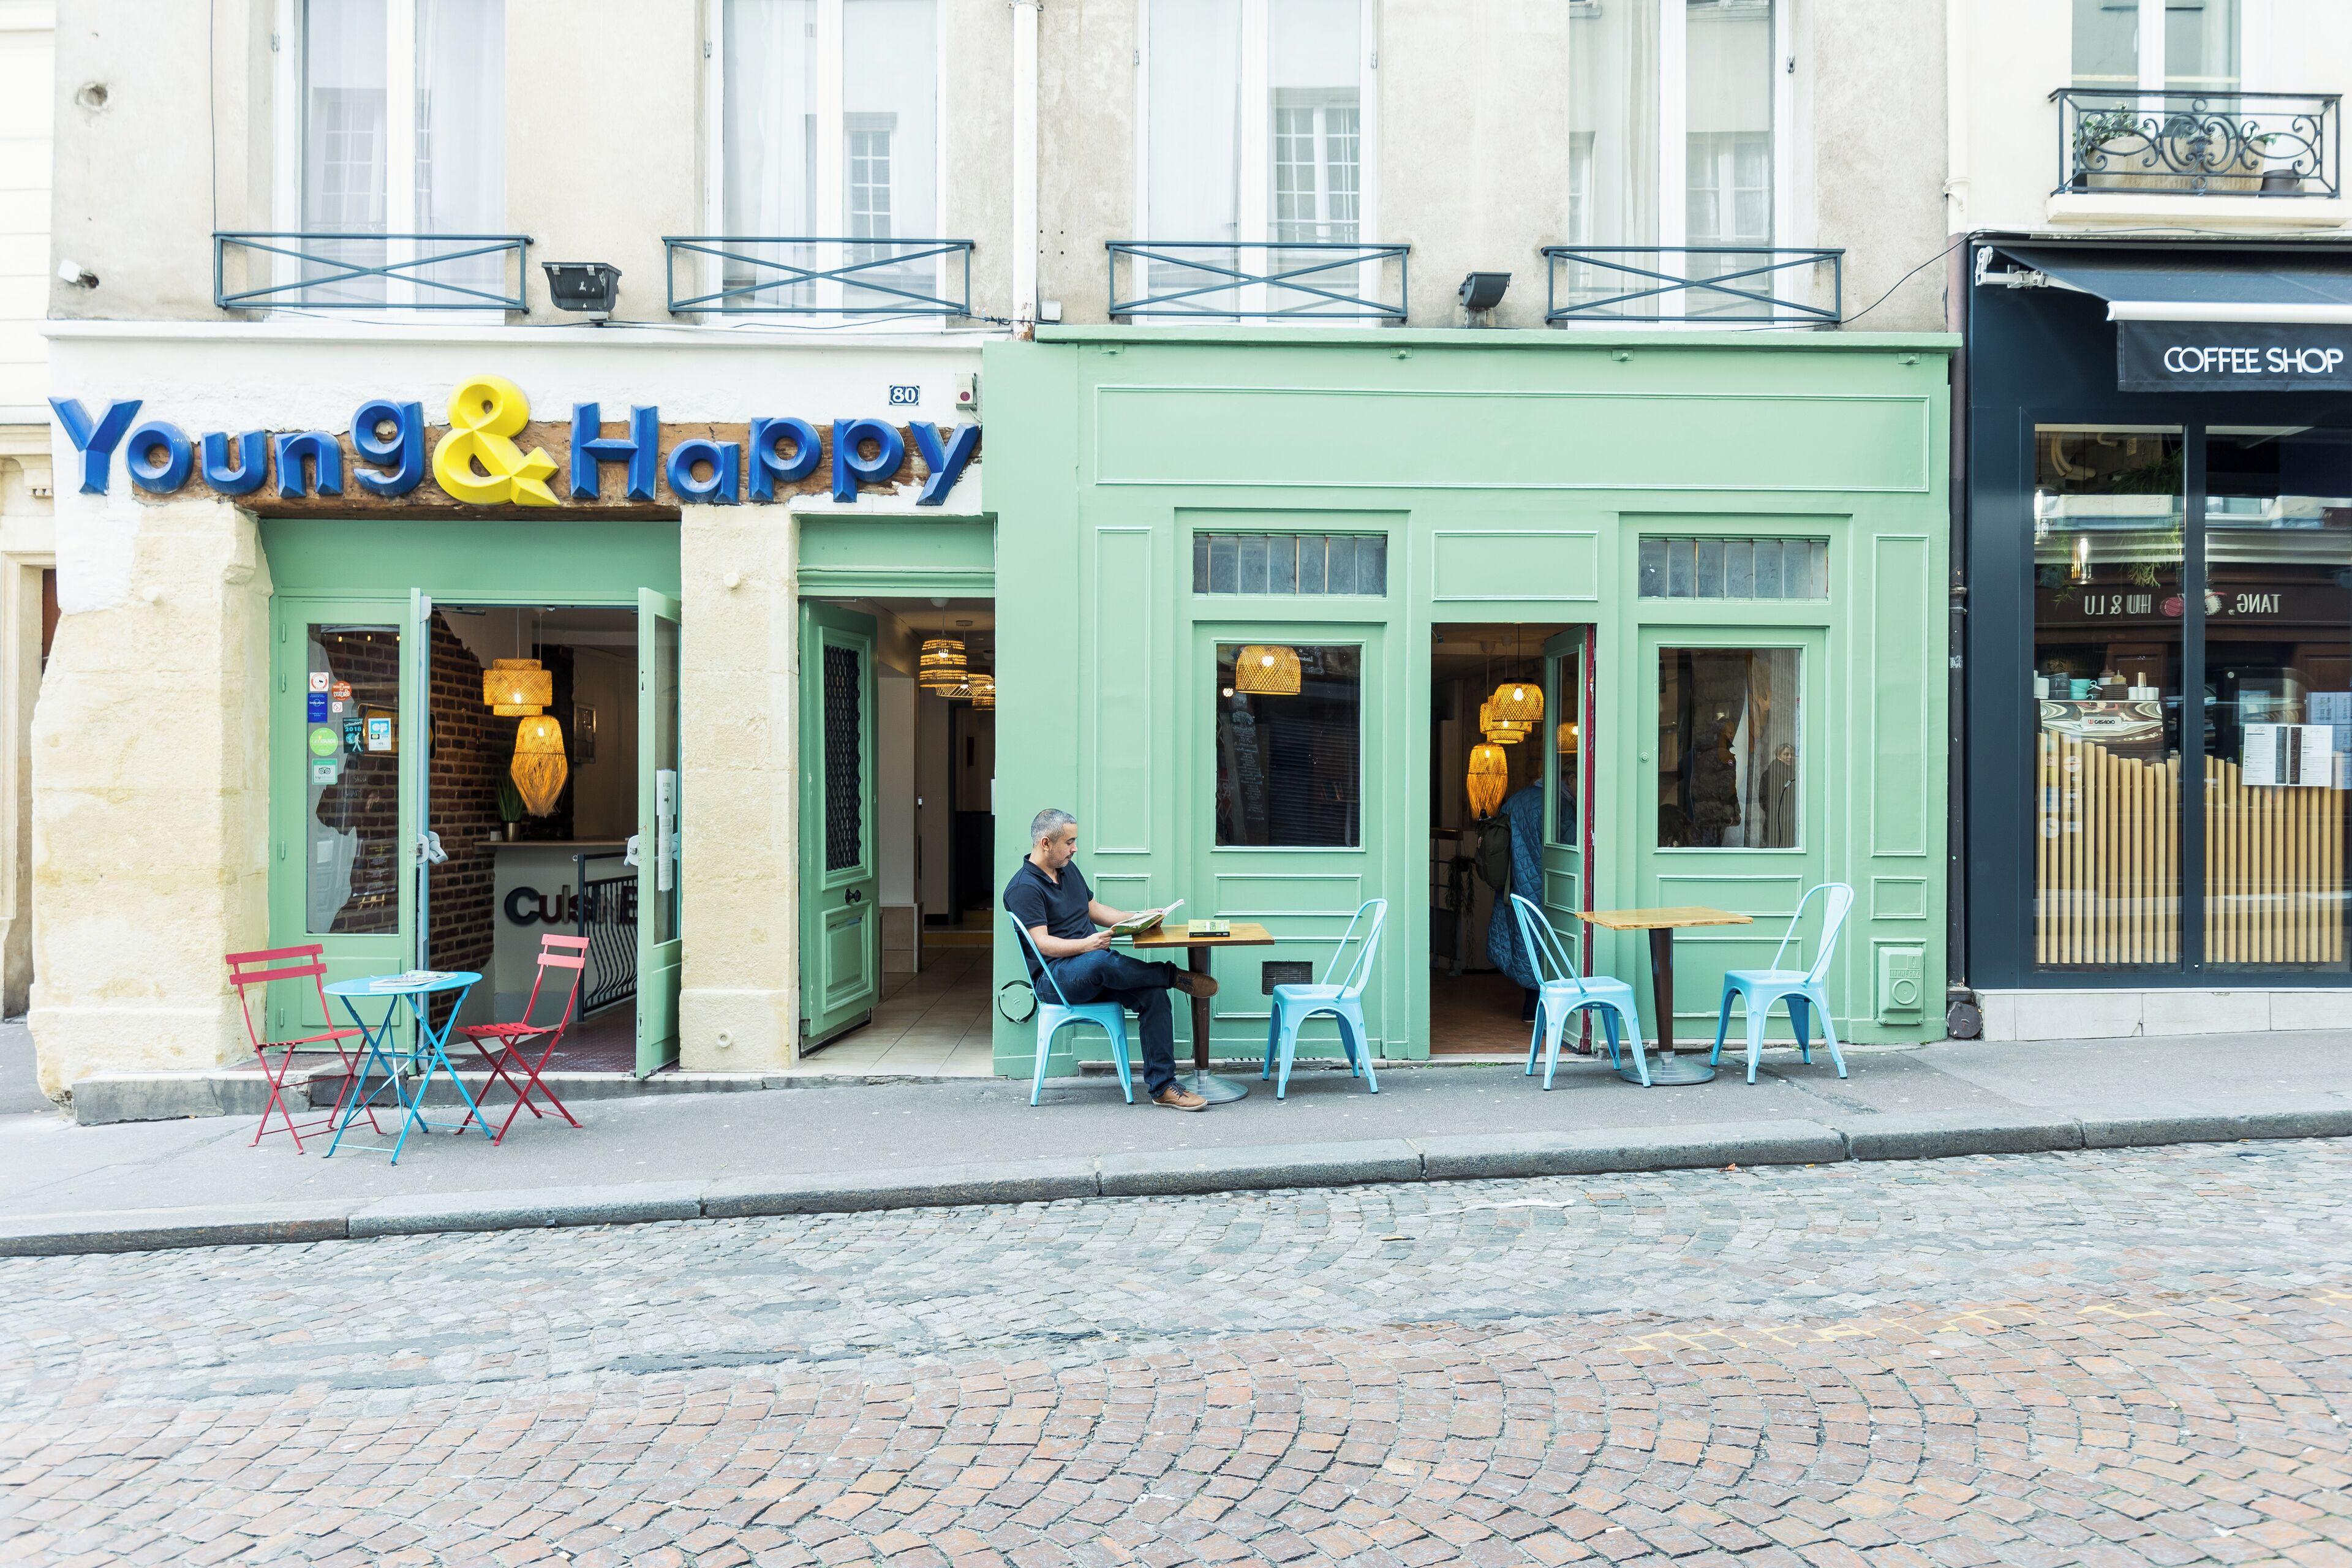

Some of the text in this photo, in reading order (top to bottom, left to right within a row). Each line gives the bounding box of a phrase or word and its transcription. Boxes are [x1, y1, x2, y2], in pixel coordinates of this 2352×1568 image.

[2163, 347, 2344, 374] COFFEE SHOP
[892, 387, 916, 402] 80
[48, 374, 980, 507] Young & Happy
